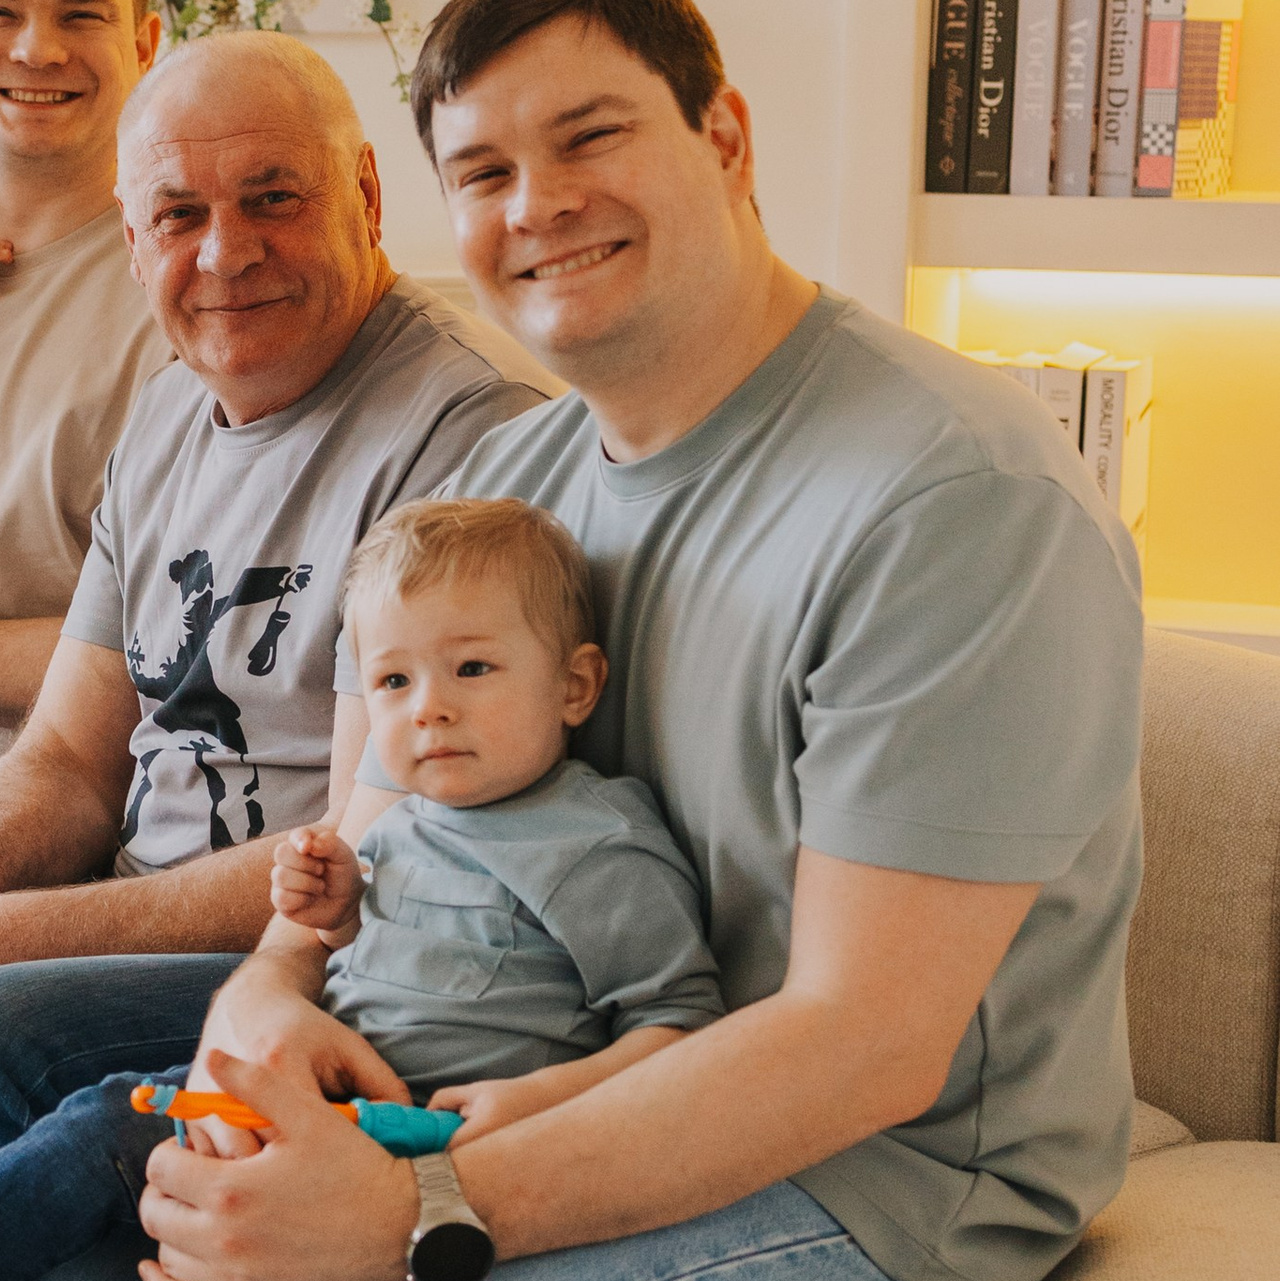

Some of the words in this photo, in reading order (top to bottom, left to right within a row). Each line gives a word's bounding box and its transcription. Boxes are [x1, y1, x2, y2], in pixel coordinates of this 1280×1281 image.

[1065, 19, 1089, 120] VOGUE
[977, 77, 1004, 138] Dior
[1104, 88, 1129, 146] Dior
